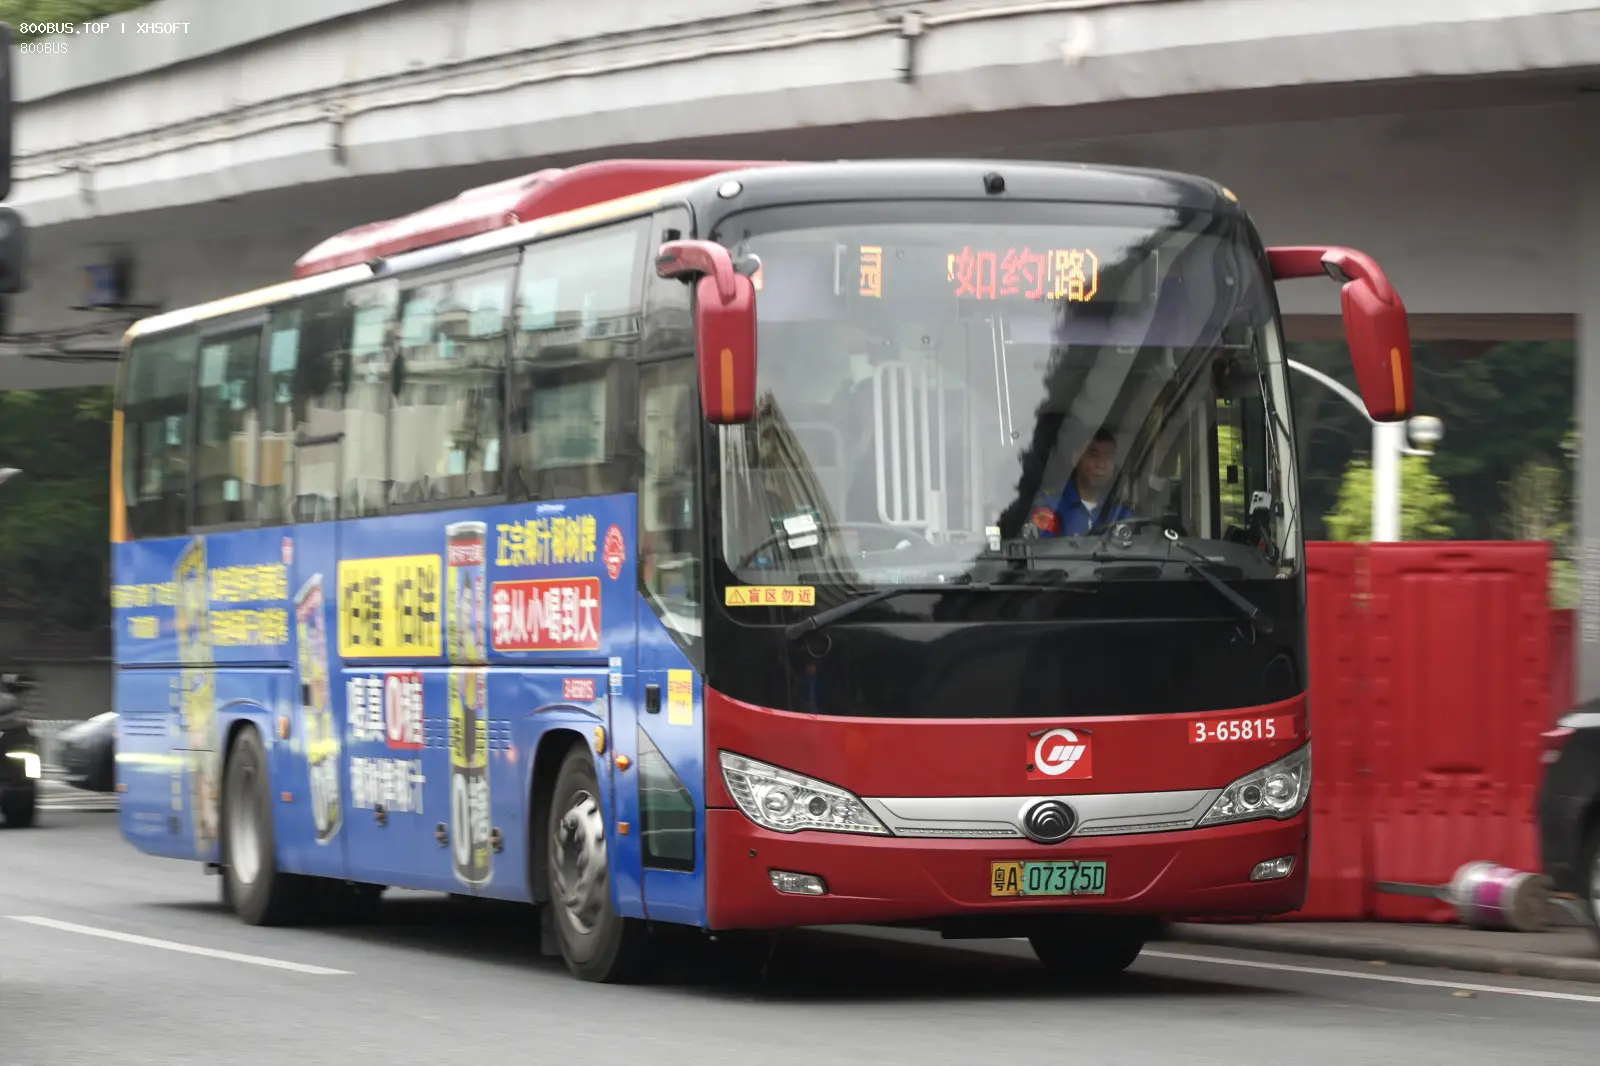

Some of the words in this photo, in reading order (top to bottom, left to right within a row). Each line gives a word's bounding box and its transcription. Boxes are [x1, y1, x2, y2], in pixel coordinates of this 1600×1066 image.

[748, 588, 812, 603] 盲区勿近
[492, 585, 599, 645] 我从小喝到大
[1194, 718, 1276, 743] 3-65815
[1029, 865, 1105, 892] 07375D
